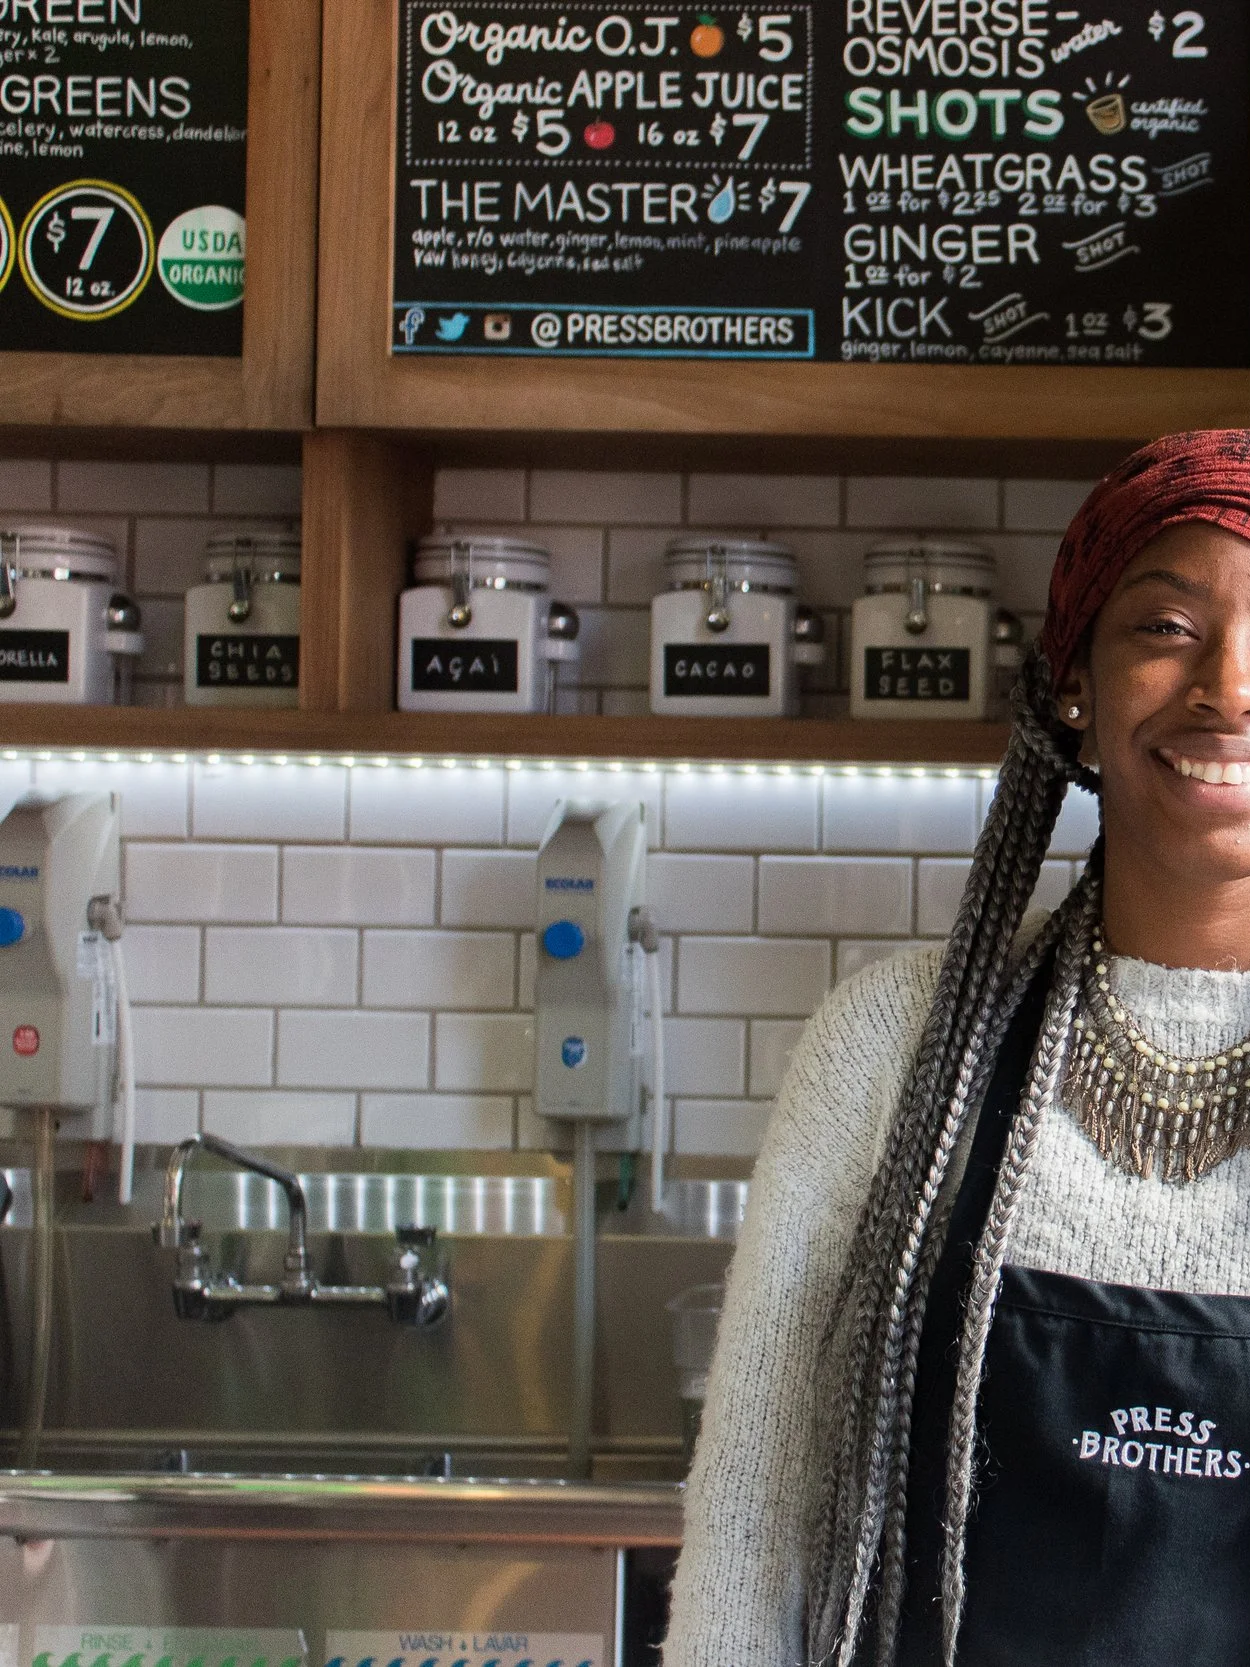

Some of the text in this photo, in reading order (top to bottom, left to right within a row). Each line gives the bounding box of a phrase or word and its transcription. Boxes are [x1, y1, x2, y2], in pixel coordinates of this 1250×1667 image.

[0, 0, 141, 25] REEN
[846, 0, 1079, 37] REVERSE-
[73, 29, 136, 51] arugula,
[140, 30, 193, 50] lemon,
[420, 10, 793, 65] Organic O.J. $5
[843, 19, 1123, 79] OSMOSIS water
[1147, 10, 1209, 58] $2
[1, 74, 191, 119] GREENS
[421, 59, 804, 120] Organic APPLE JUICE
[845, 86, 1066, 141] SHOTS
[1130, 98, 1208, 118] certified
[437, 109, 571, 157] 12 oz $5
[637, 112, 770, 162] 16 oz $7
[1130, 117, 1201, 140] organic
[32, 139, 84, 158] lemon
[839, 153, 1148, 193] WHEATGRASS
[410, 176, 812, 233] THE MASTER $7
[898, 191, 930, 215] for
[1072, 193, 1107, 217] for
[47, 207, 115, 270] $7
[181, 228, 242, 252] USDA
[411, 228, 464, 250] apple,
[714, 235, 801, 258] pineapple
[843, 223, 1127, 264] GINGER SHOT
[66, 277, 84, 297] 12
[895, 265, 932, 288] for
[530, 312, 795, 348] @PRESSBROTHERS
[842, 297, 953, 339] KICK
[982, 302, 1029, 336] SHOT
[211, 640, 282, 659] CHIA
[881, 650, 952, 672] FLAX
[674, 664, 756, 680] CACAO
[879, 674, 955, 697] SEED
[1110, 1406, 1217, 1445] PRESS
[399, 1634, 528, 1652] WASH LAVAR
